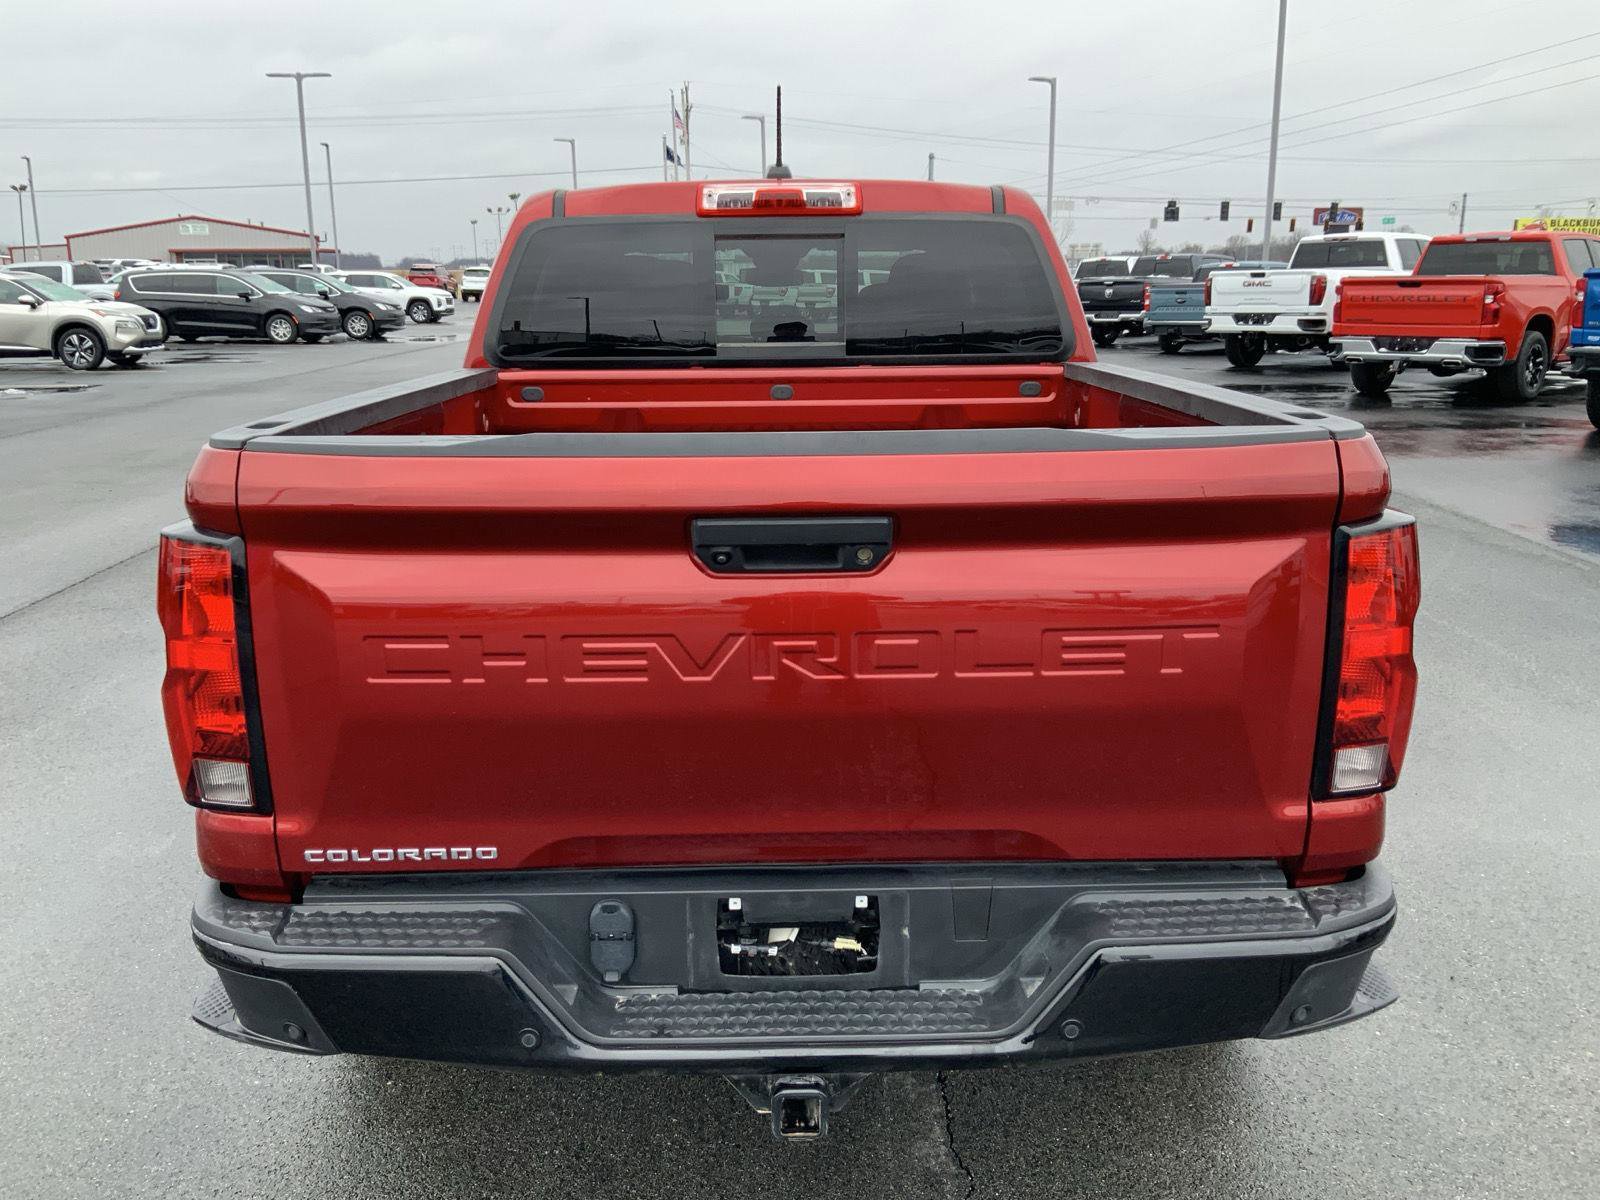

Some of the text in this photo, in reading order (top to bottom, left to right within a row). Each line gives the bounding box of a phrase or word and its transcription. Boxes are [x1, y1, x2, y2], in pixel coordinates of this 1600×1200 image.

[1242, 280, 1272, 288] GMC
[1349, 295, 1471, 303] CHEVROLET
[362, 624, 1221, 685] CHEVROLET
[303, 846, 498, 862] COLORADO
